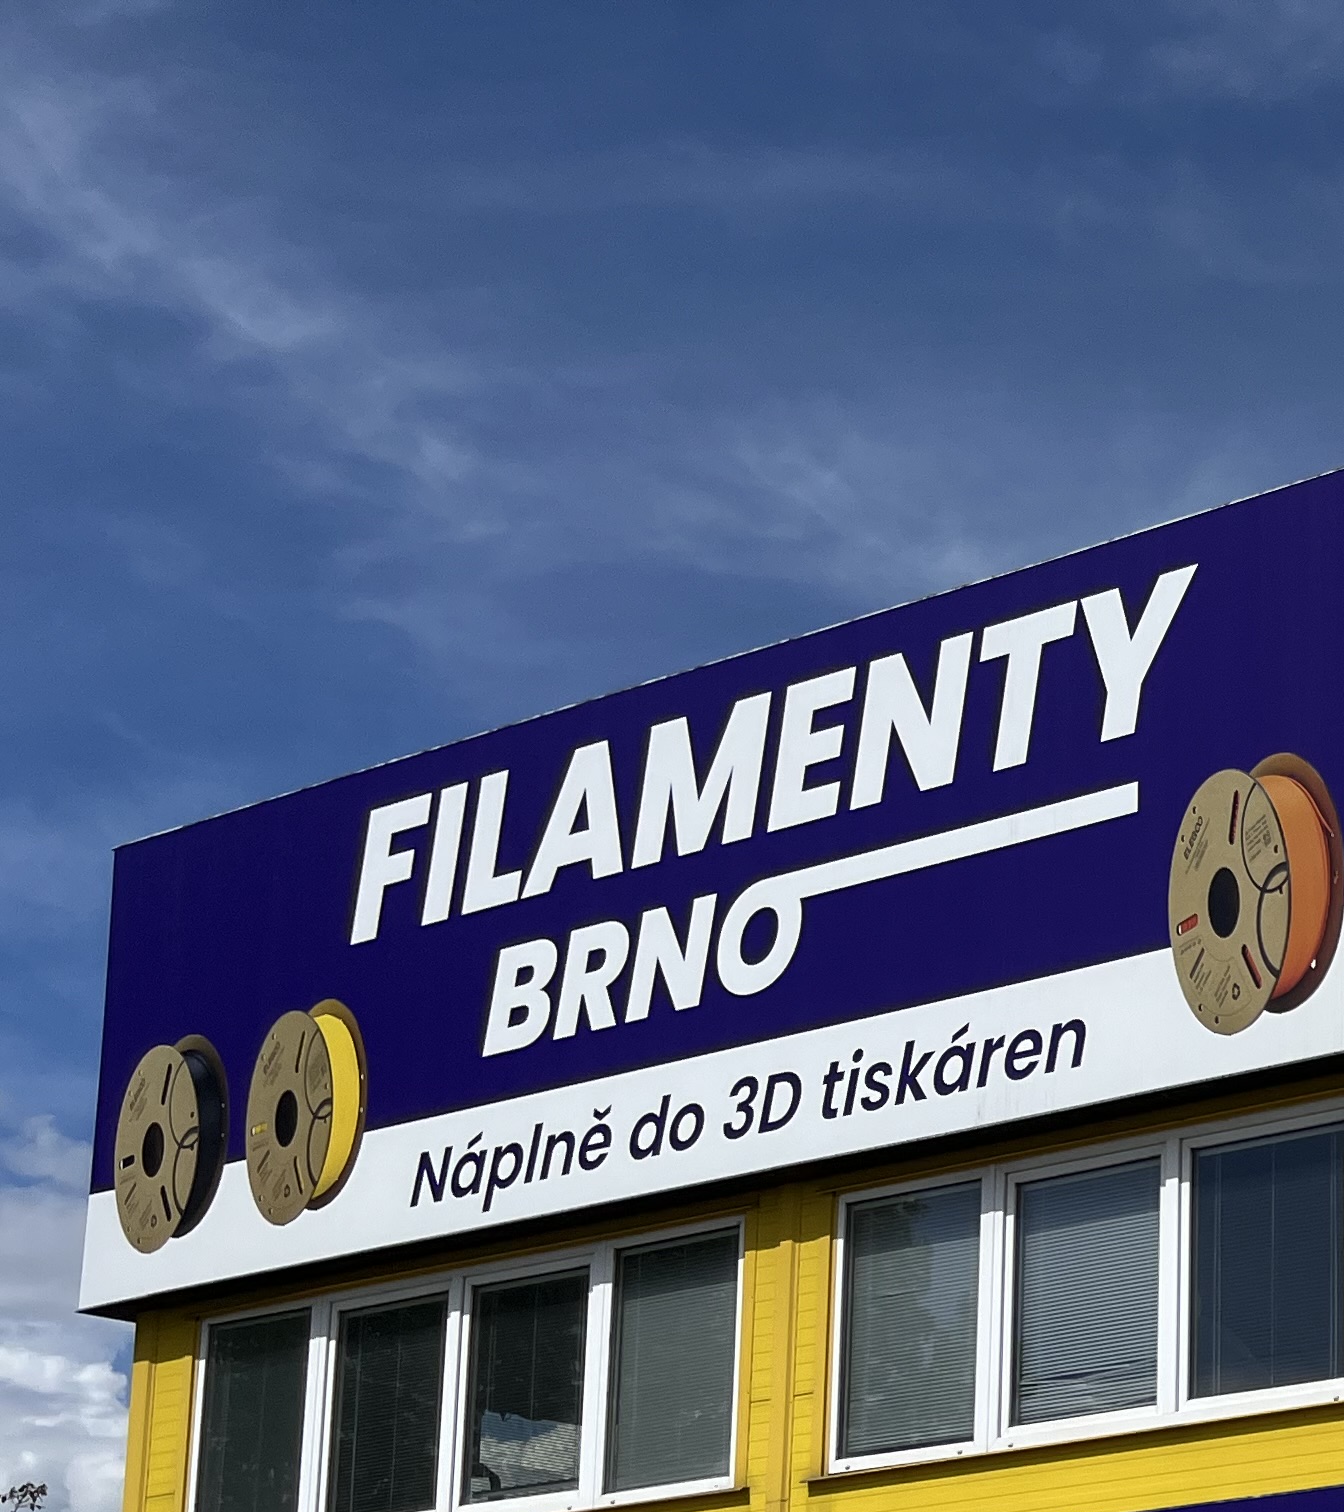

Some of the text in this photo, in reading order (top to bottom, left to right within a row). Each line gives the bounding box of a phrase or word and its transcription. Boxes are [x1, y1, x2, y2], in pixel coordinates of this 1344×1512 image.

[350, 563, 1199, 946] FILAMENTY
[481, 879, 803, 1057] BRNO
[410, 1018, 1087, 1212] Náplně do 3D tiskáren
